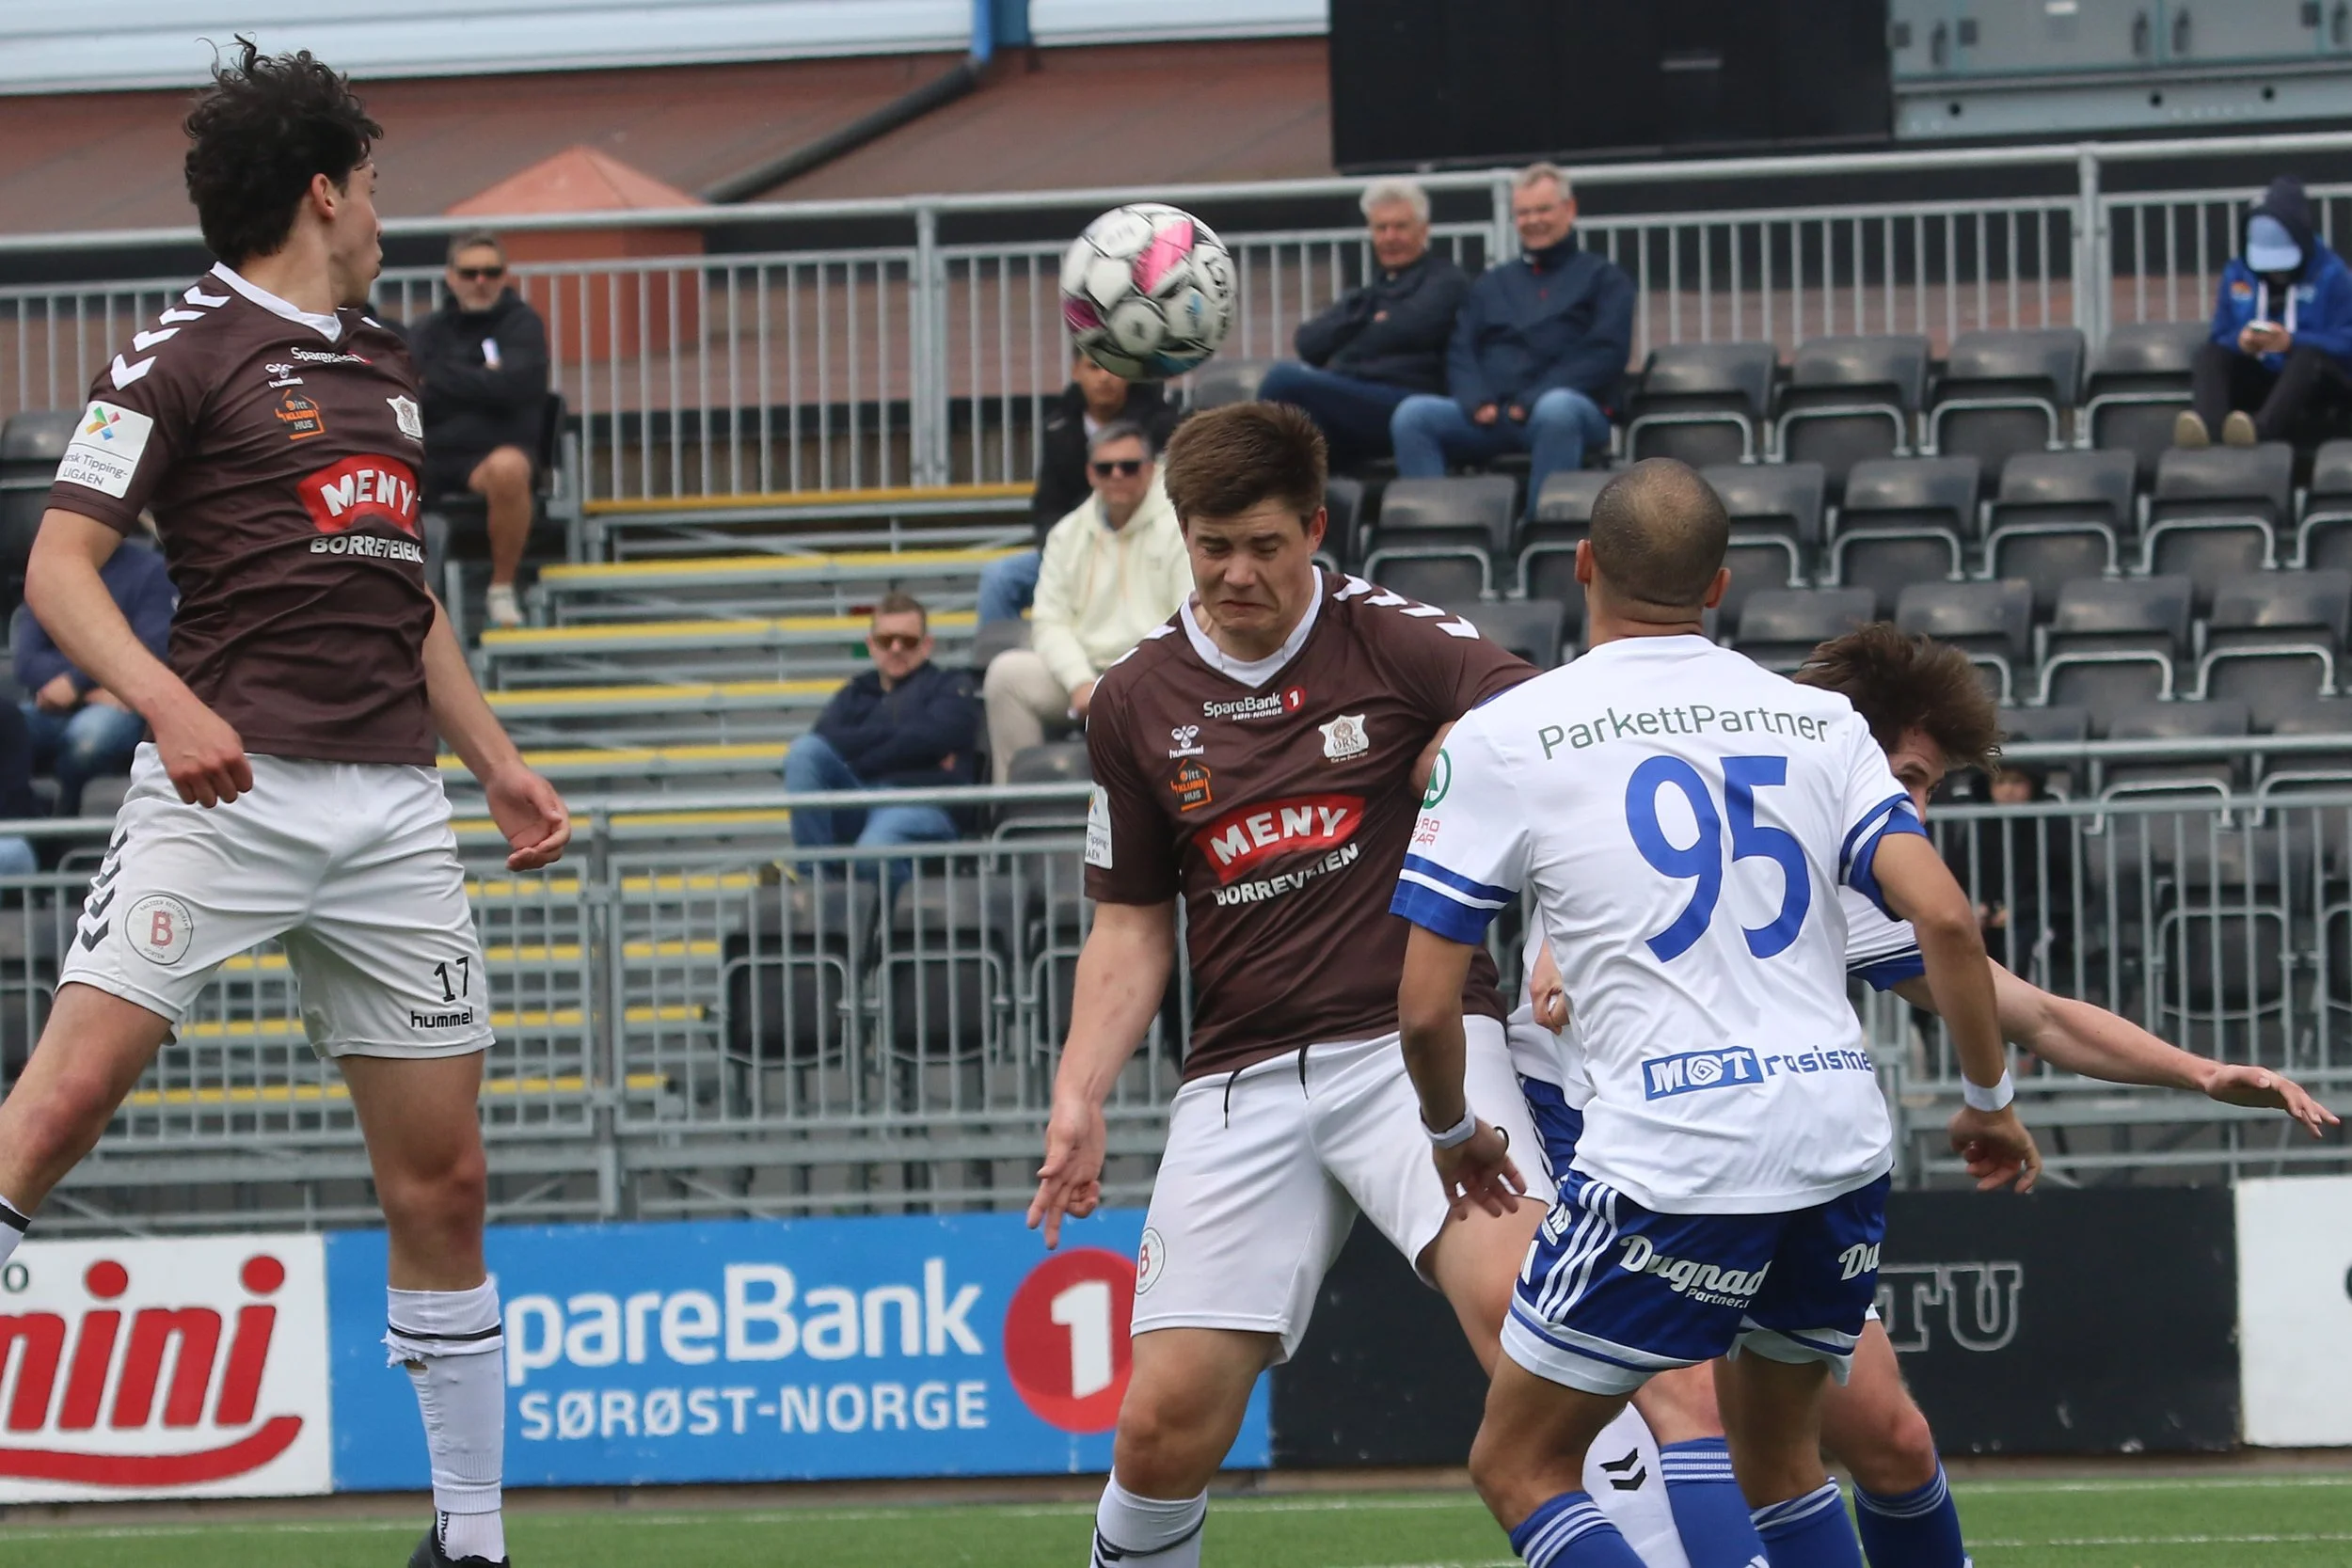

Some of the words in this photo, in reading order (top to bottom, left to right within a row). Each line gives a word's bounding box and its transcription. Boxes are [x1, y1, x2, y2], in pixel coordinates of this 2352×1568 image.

[63, 452, 81, 464] orsk
[83, 454, 128, 480] Tipping-
[320, 469, 414, 517] MENY
[1203, 691, 1281, 719] SpareBank
[1168, 744, 1204, 760] hummel
[1537, 705, 1829, 760] ParkettPartner
[1210, 805, 1348, 866] MENY
[1625, 755, 1811, 964] 95
[434, 956, 469, 1003] 17
[410, 1006, 473, 1029] hummel
[1619, 1234, 1772, 1296] Dugnad
[487, 1257, 985, 1389] pareBank
[1050, 1278, 1114, 1401] 1
[518, 1381, 990, 1442] SØRØST-NORGE
